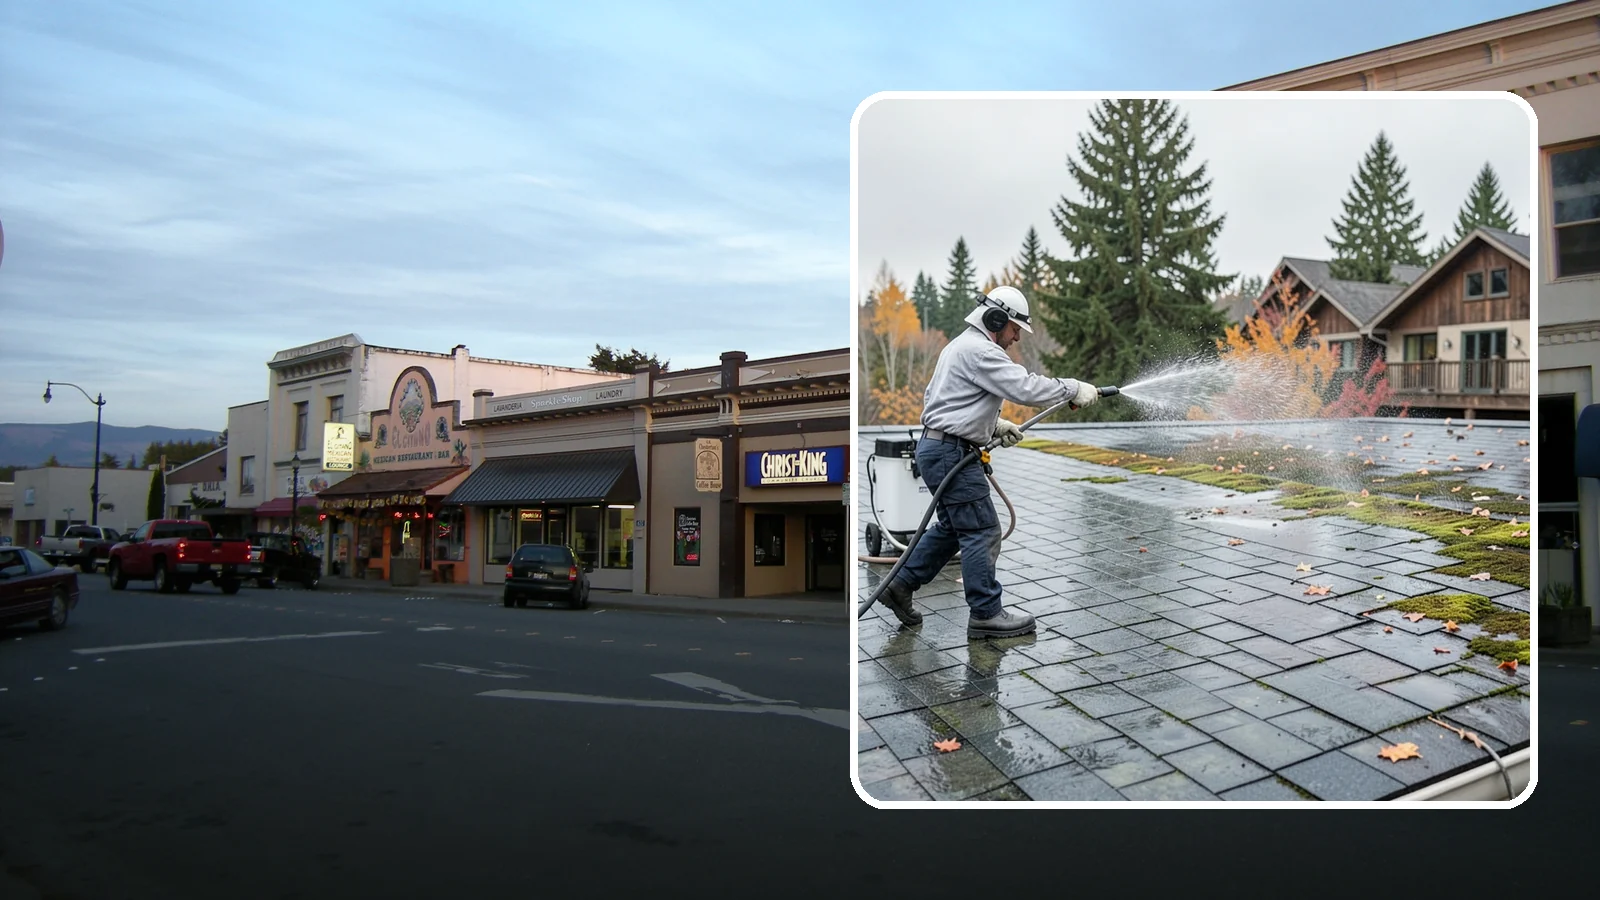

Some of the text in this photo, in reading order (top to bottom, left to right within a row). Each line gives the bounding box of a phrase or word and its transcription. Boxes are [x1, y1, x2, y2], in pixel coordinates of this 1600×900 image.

[595, 388, 624, 400] LAUNDRY
[493, 402, 523, 412] LAVANDERIA
[531, 394, 583, 408] Sparkle Shop
[373, 455, 396, 464] MEXICAN
[397, 451, 433, 462] RESTAURANT
[437, 450, 450, 459] BAR
[799, 449, 828, 477] KING
[696, 481, 709, 489] Coffee
